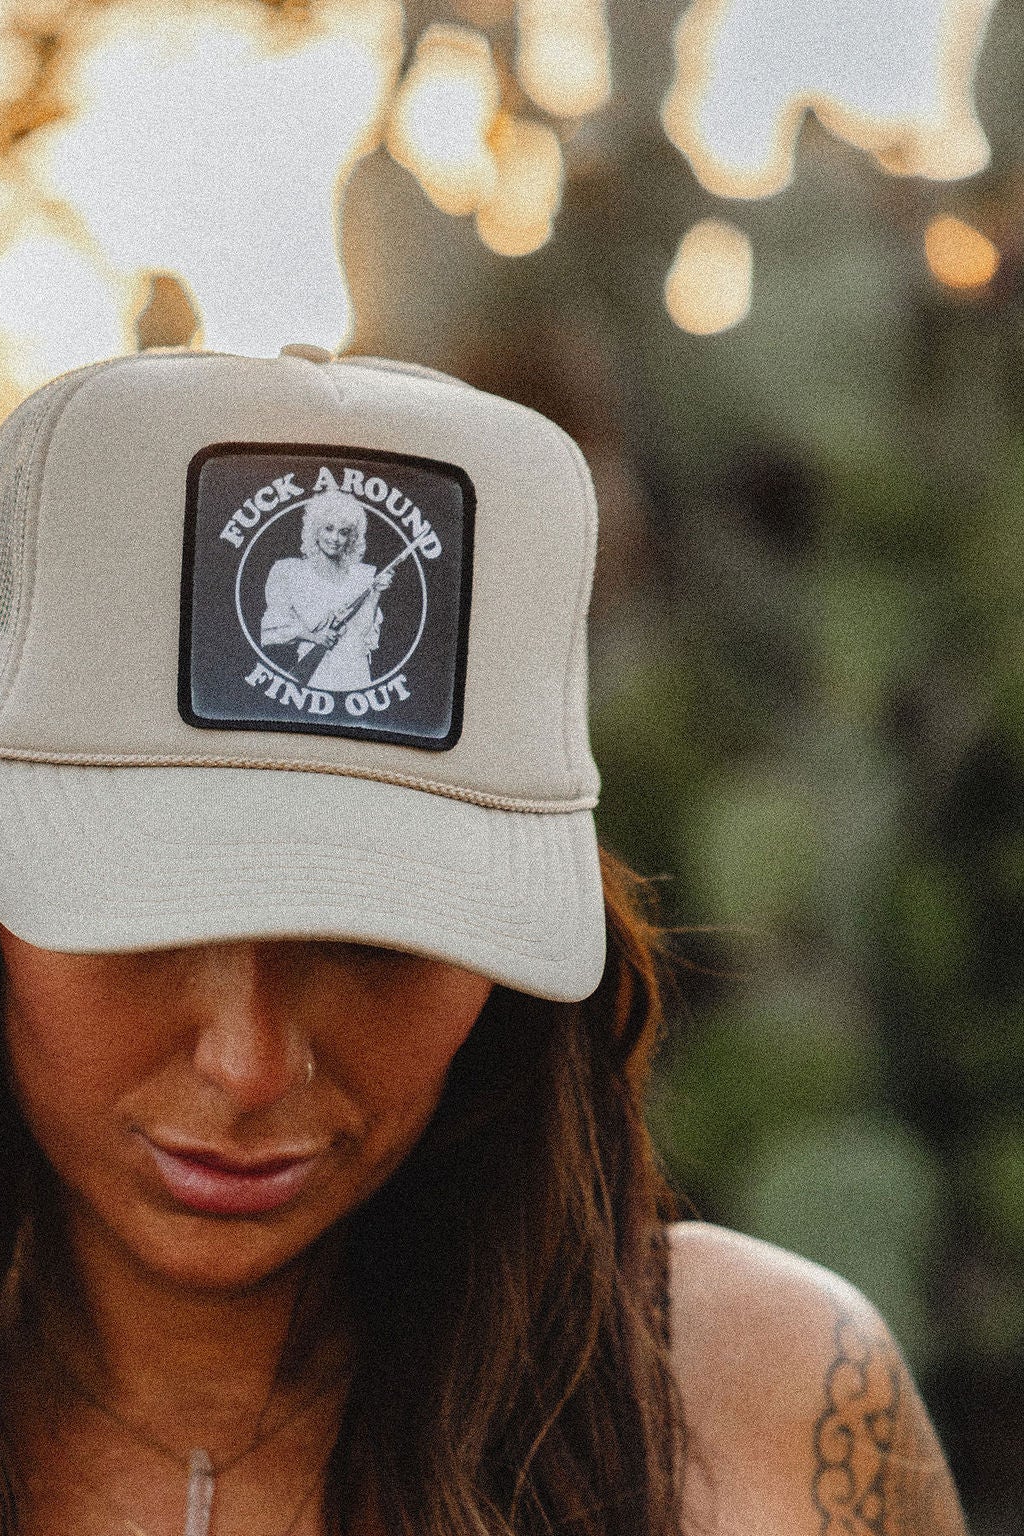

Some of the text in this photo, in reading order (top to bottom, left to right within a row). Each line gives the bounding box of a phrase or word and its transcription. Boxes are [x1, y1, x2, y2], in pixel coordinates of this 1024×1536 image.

[219, 466, 443, 560] FUCK AROUND
[244, 662, 411, 716] FIND OUT
